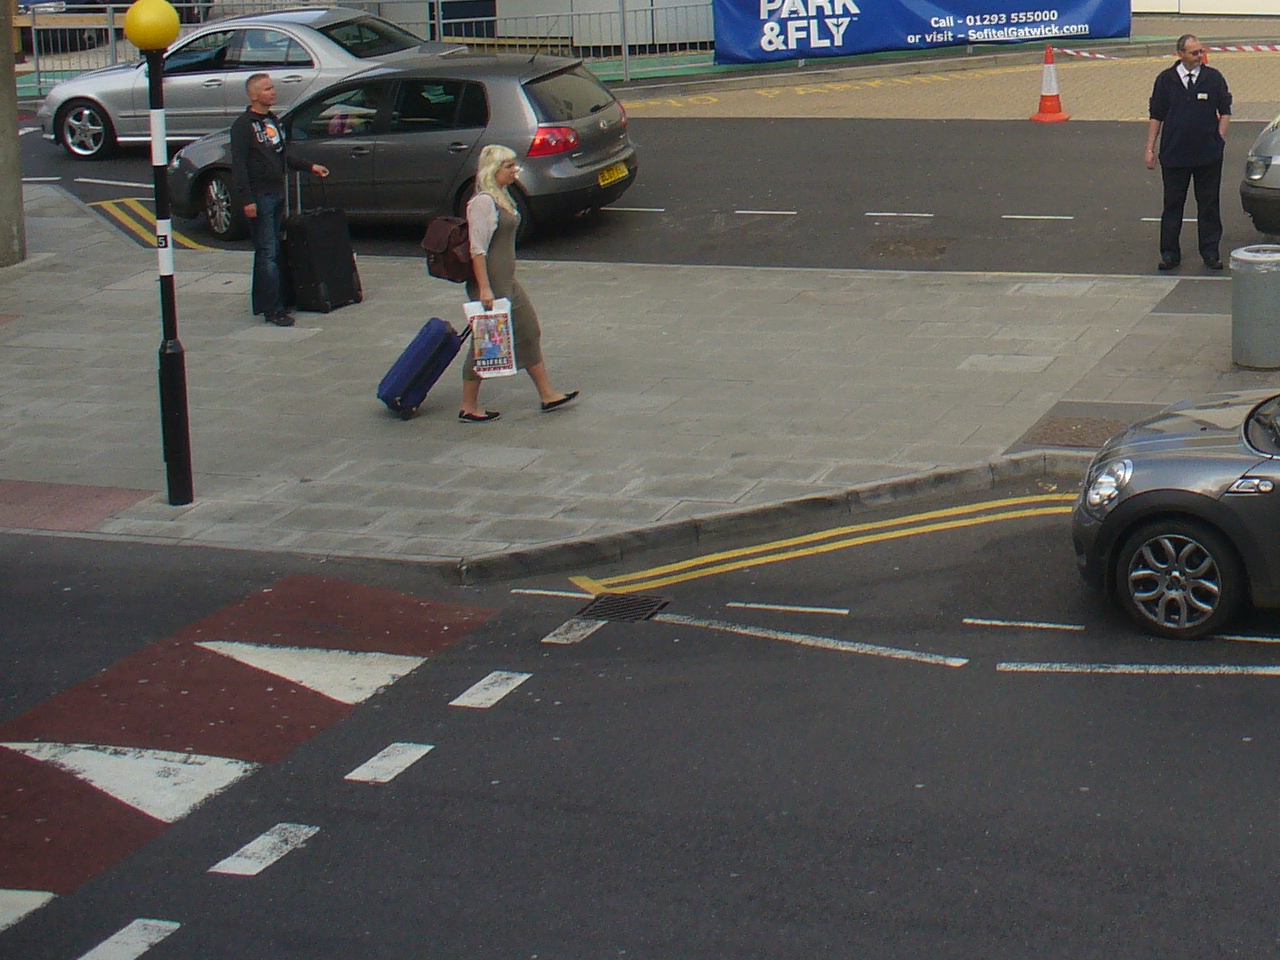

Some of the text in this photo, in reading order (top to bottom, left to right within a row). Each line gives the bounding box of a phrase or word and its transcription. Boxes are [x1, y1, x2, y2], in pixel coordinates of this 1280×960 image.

[931, 16, 954, 28] Call
[966, 13, 1006, 26] 01293
[1010, 10, 1058, 23] 555000
[907, 33, 921, 44] or
[925, 30, 953, 42] visit
[968, 23, 1090, 40] SofitelGatwick.com
